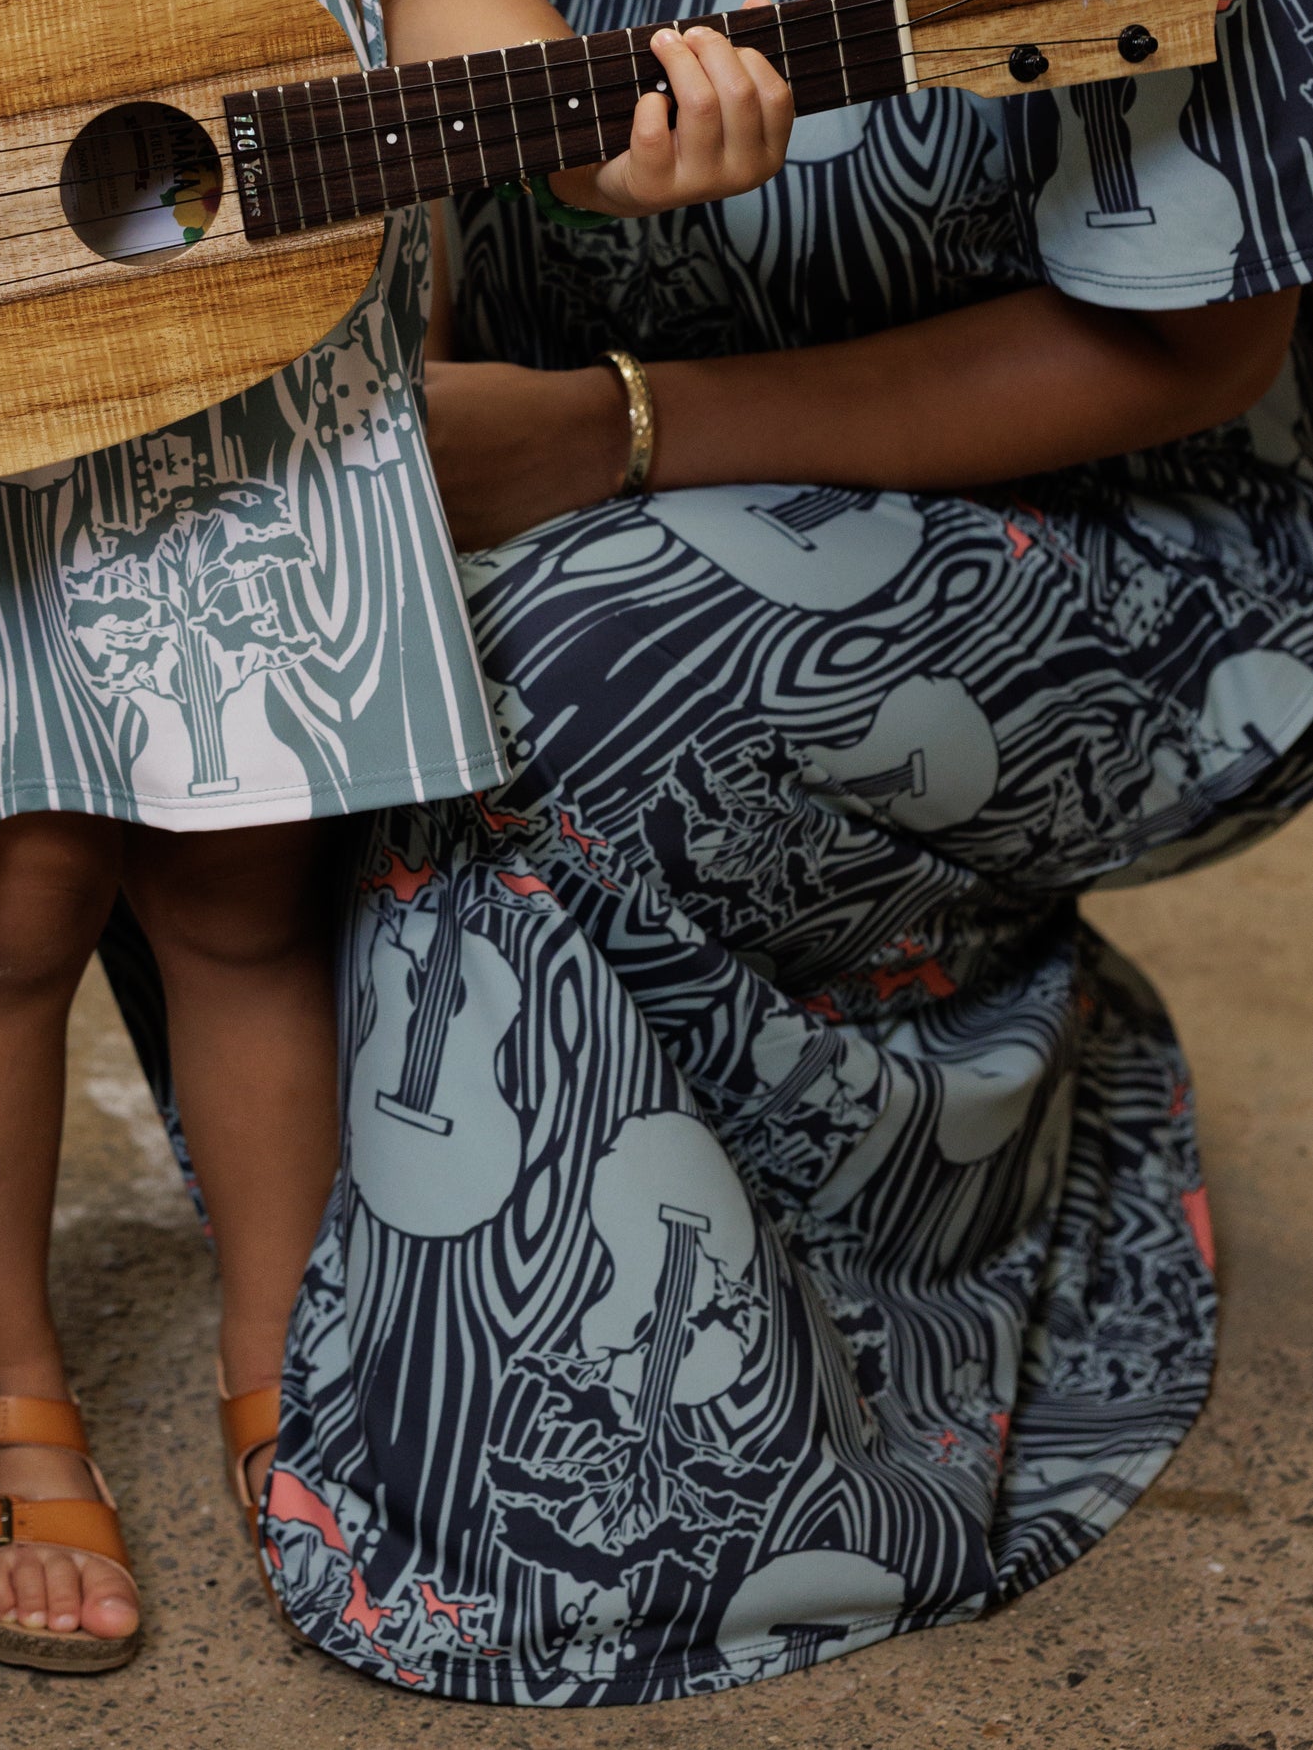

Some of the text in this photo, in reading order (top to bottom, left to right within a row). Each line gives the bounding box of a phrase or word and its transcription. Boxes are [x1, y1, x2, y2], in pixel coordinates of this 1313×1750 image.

[162, 107, 200, 193] AMAKA
[233, 114, 263, 217] 110 Years
